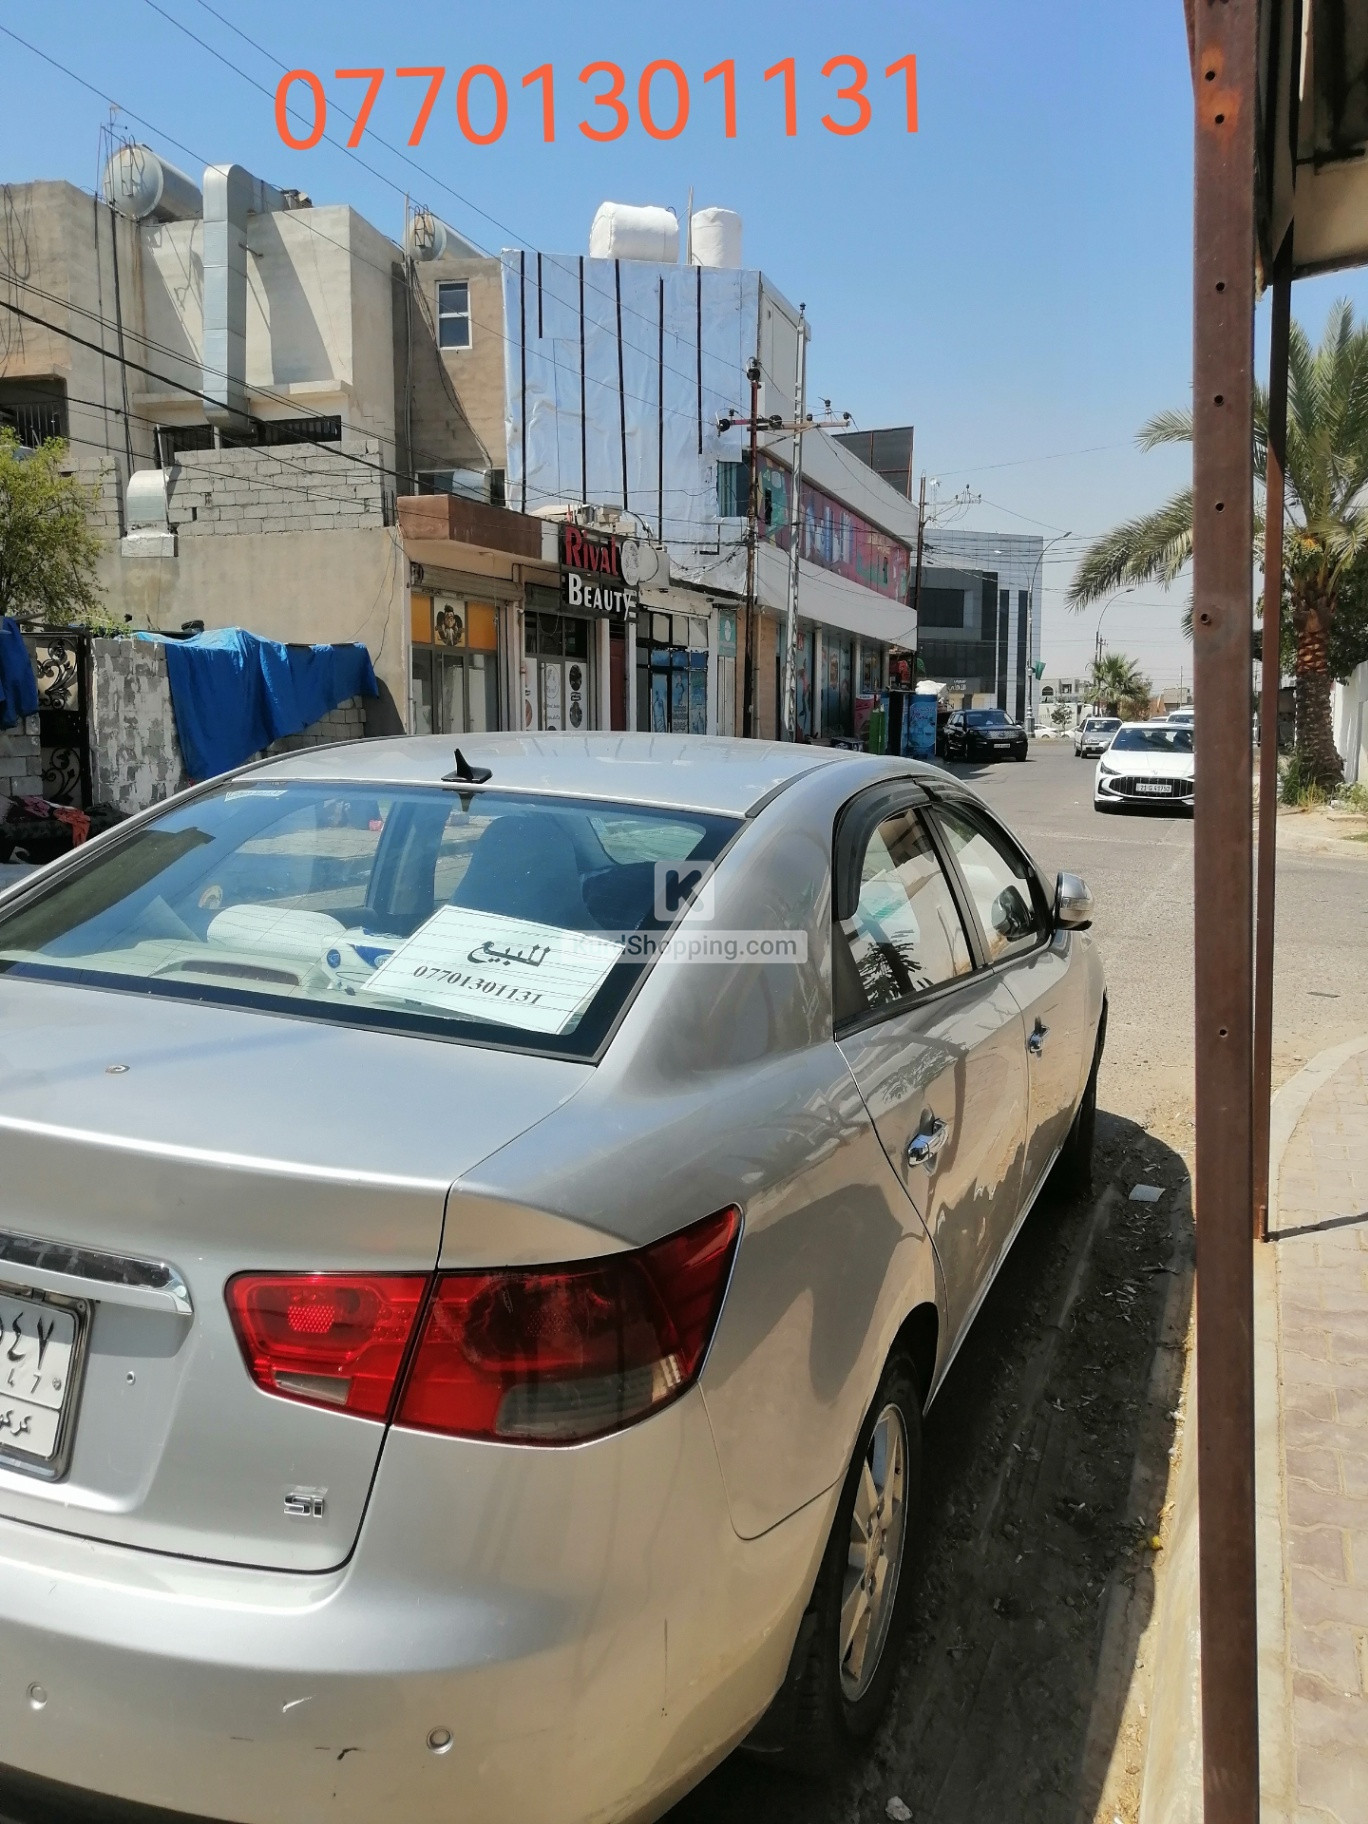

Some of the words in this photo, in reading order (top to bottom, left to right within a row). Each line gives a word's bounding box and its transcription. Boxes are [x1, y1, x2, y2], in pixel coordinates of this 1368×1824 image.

[568, 572, 632, 621] BEAUTY
[467, 941, 551, 967] للبيع
[413, 965, 543, 1005] 07701301131
[0, 1311, 55, 1371] ٤٧
